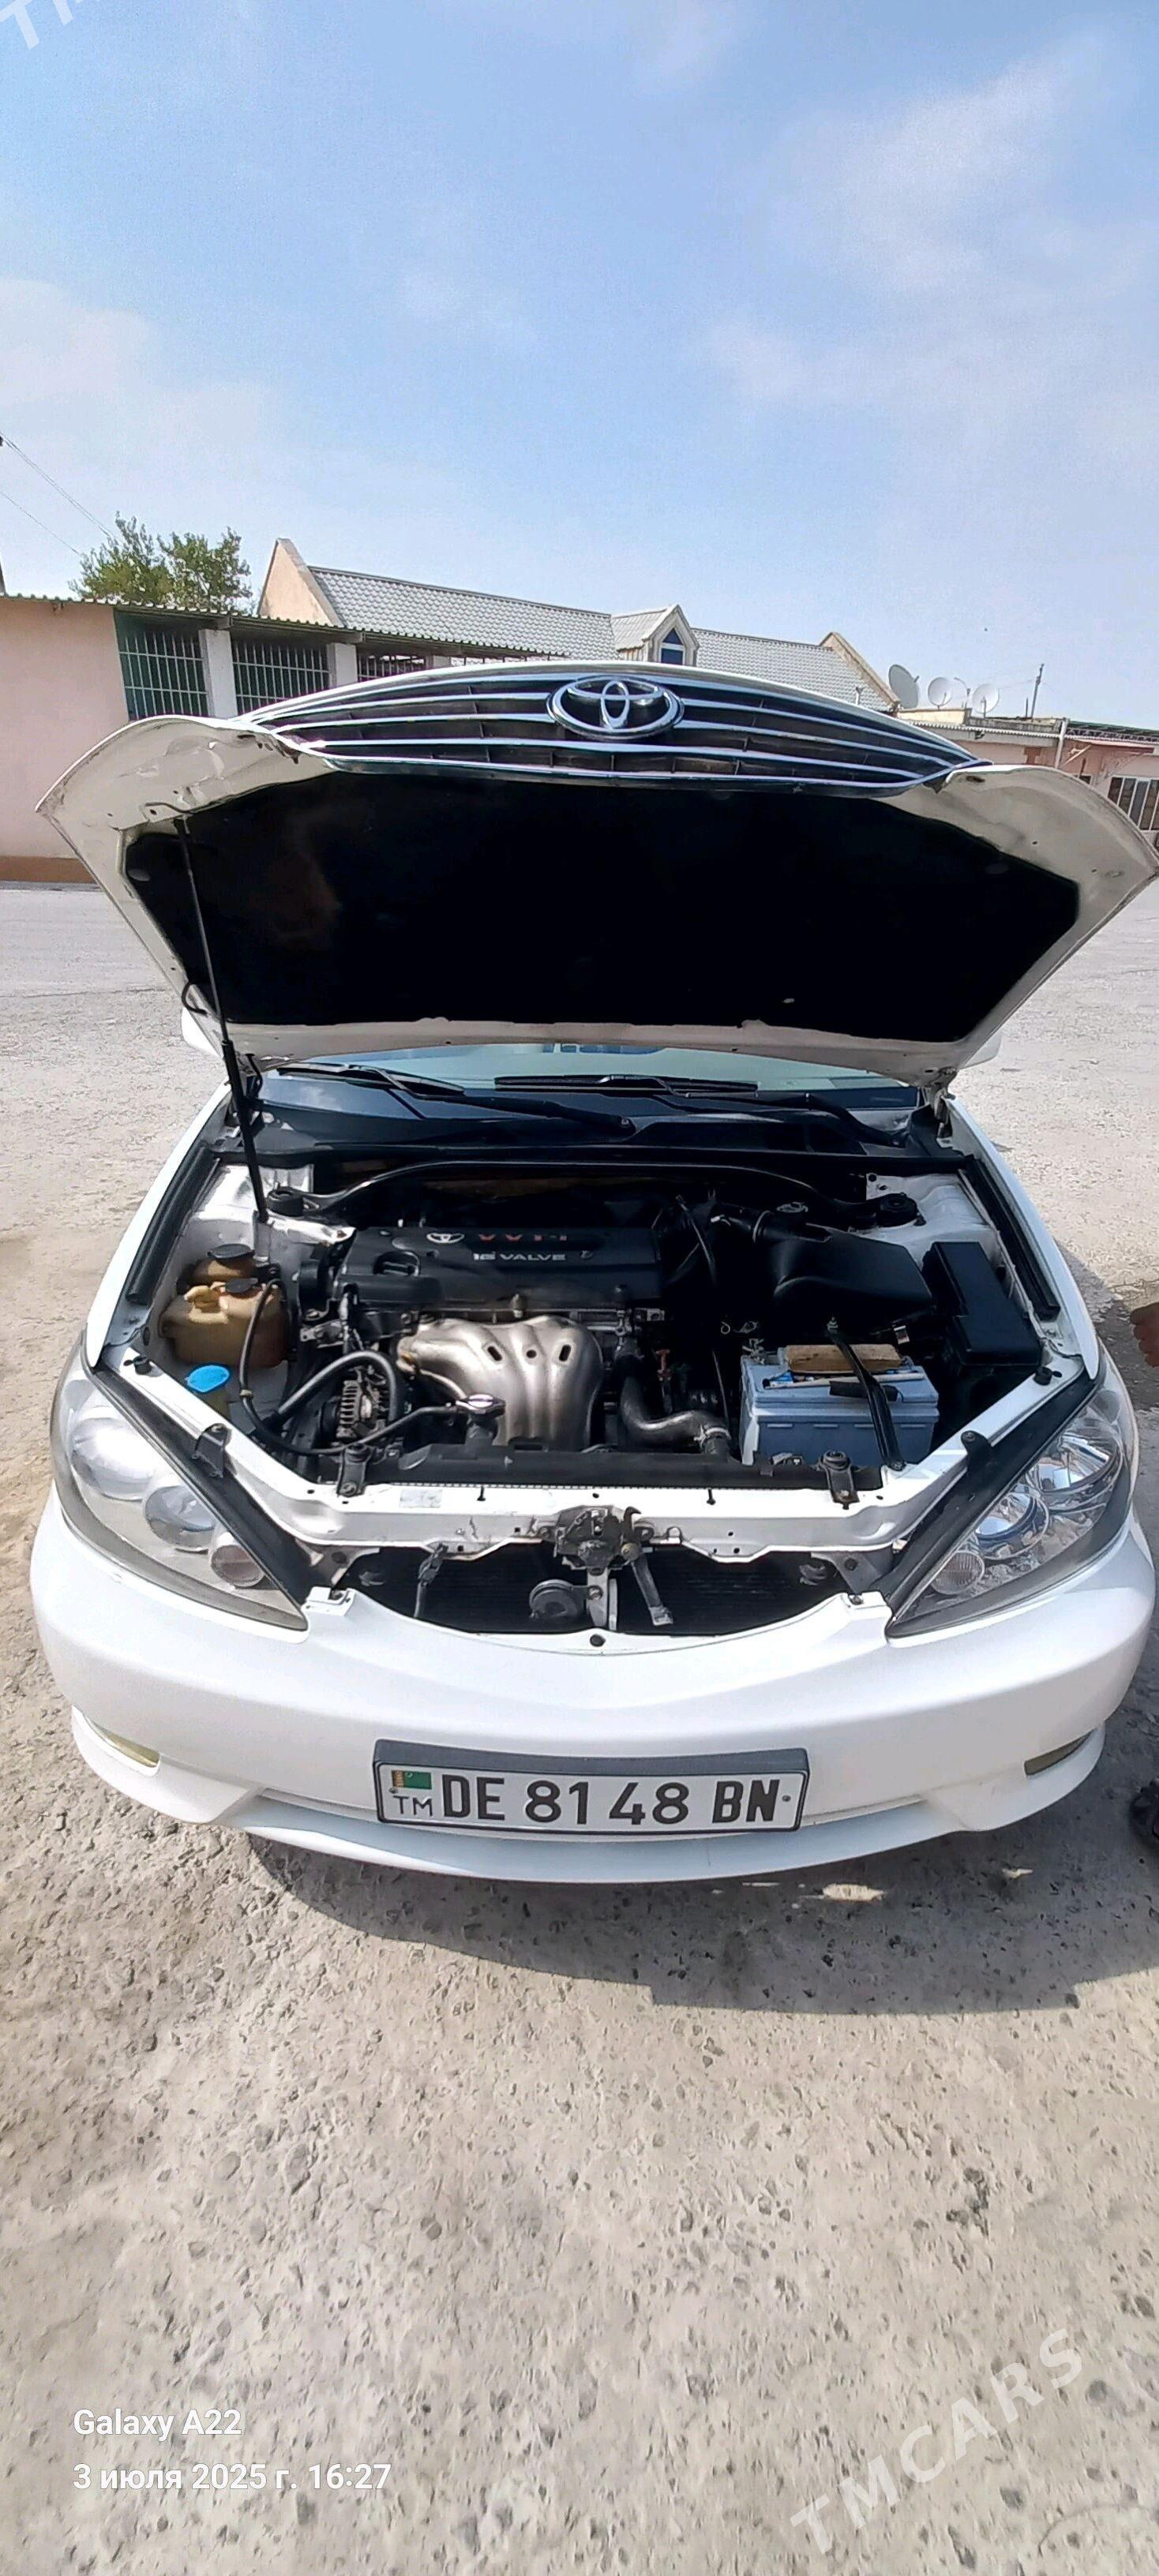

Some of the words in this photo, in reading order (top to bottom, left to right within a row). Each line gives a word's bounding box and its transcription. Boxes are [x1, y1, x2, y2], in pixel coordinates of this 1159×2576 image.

[474, 1251, 496, 1260] 16
[500, 1252, 566, 1261] VALVE
[392, 1795, 433, 1817] TM
[442, 1774, 505, 1821] DE
[711, 1779, 780, 1824] BN
